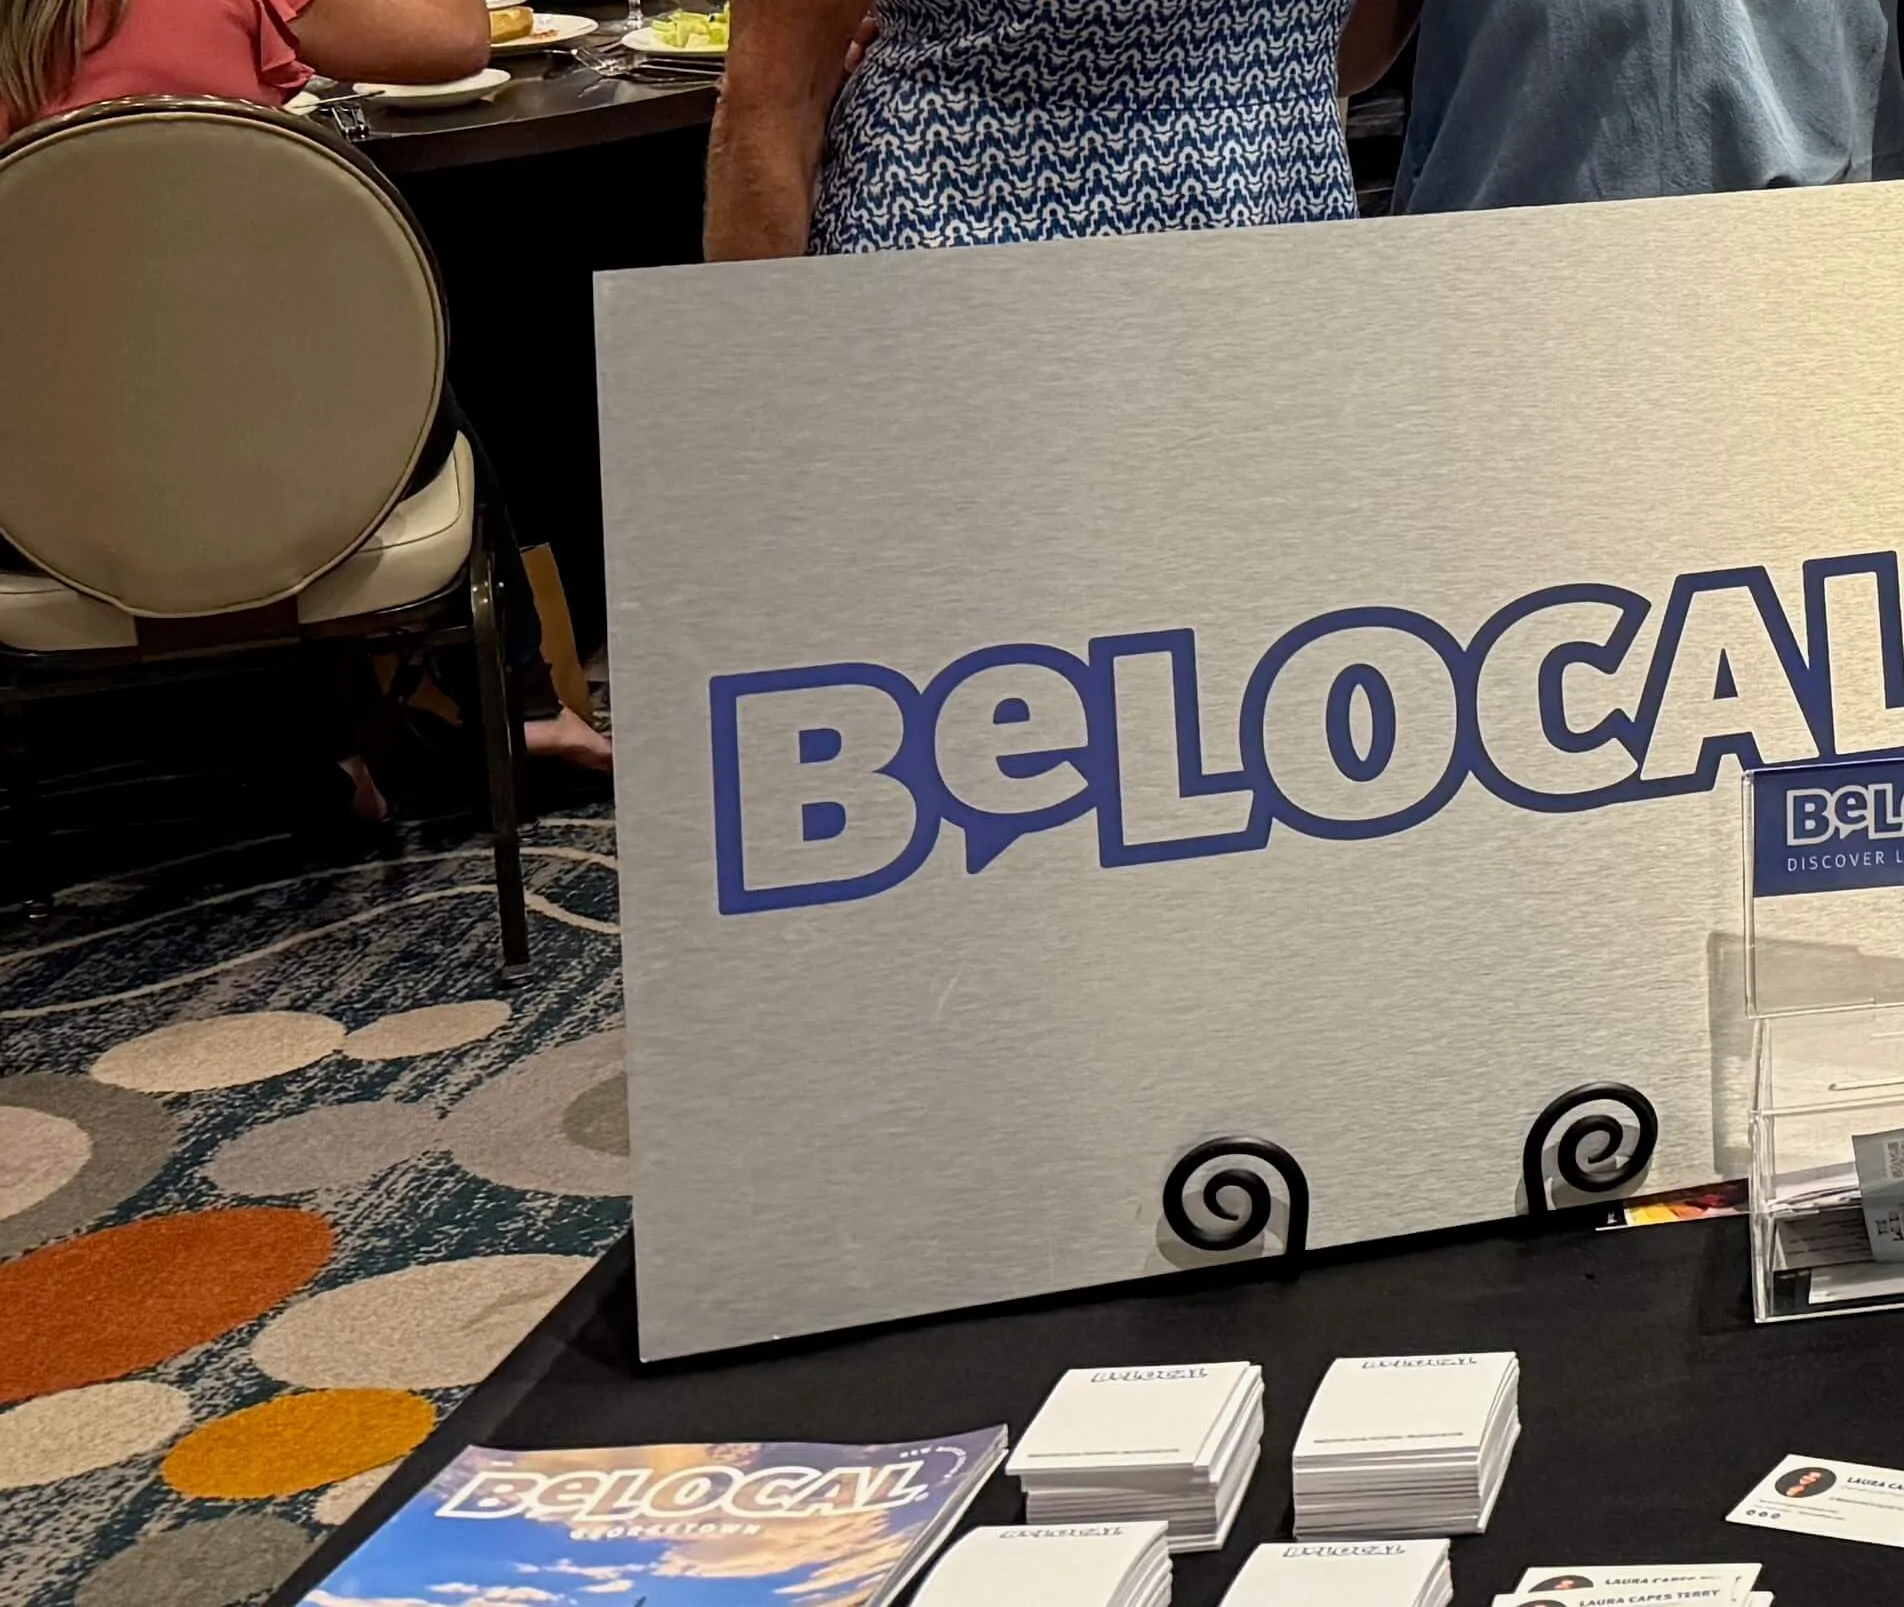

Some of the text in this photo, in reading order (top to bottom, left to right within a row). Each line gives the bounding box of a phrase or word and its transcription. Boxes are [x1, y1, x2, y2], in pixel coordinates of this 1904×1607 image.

[1788, 850, 1885, 872] DISCOVER
[1847, 1477, 1887, 1490] LAURA
[570, 1523, 760, 1540] GEORGETOWN
[1580, 1589, 1720, 1607] LAURA CAPES TERRY
